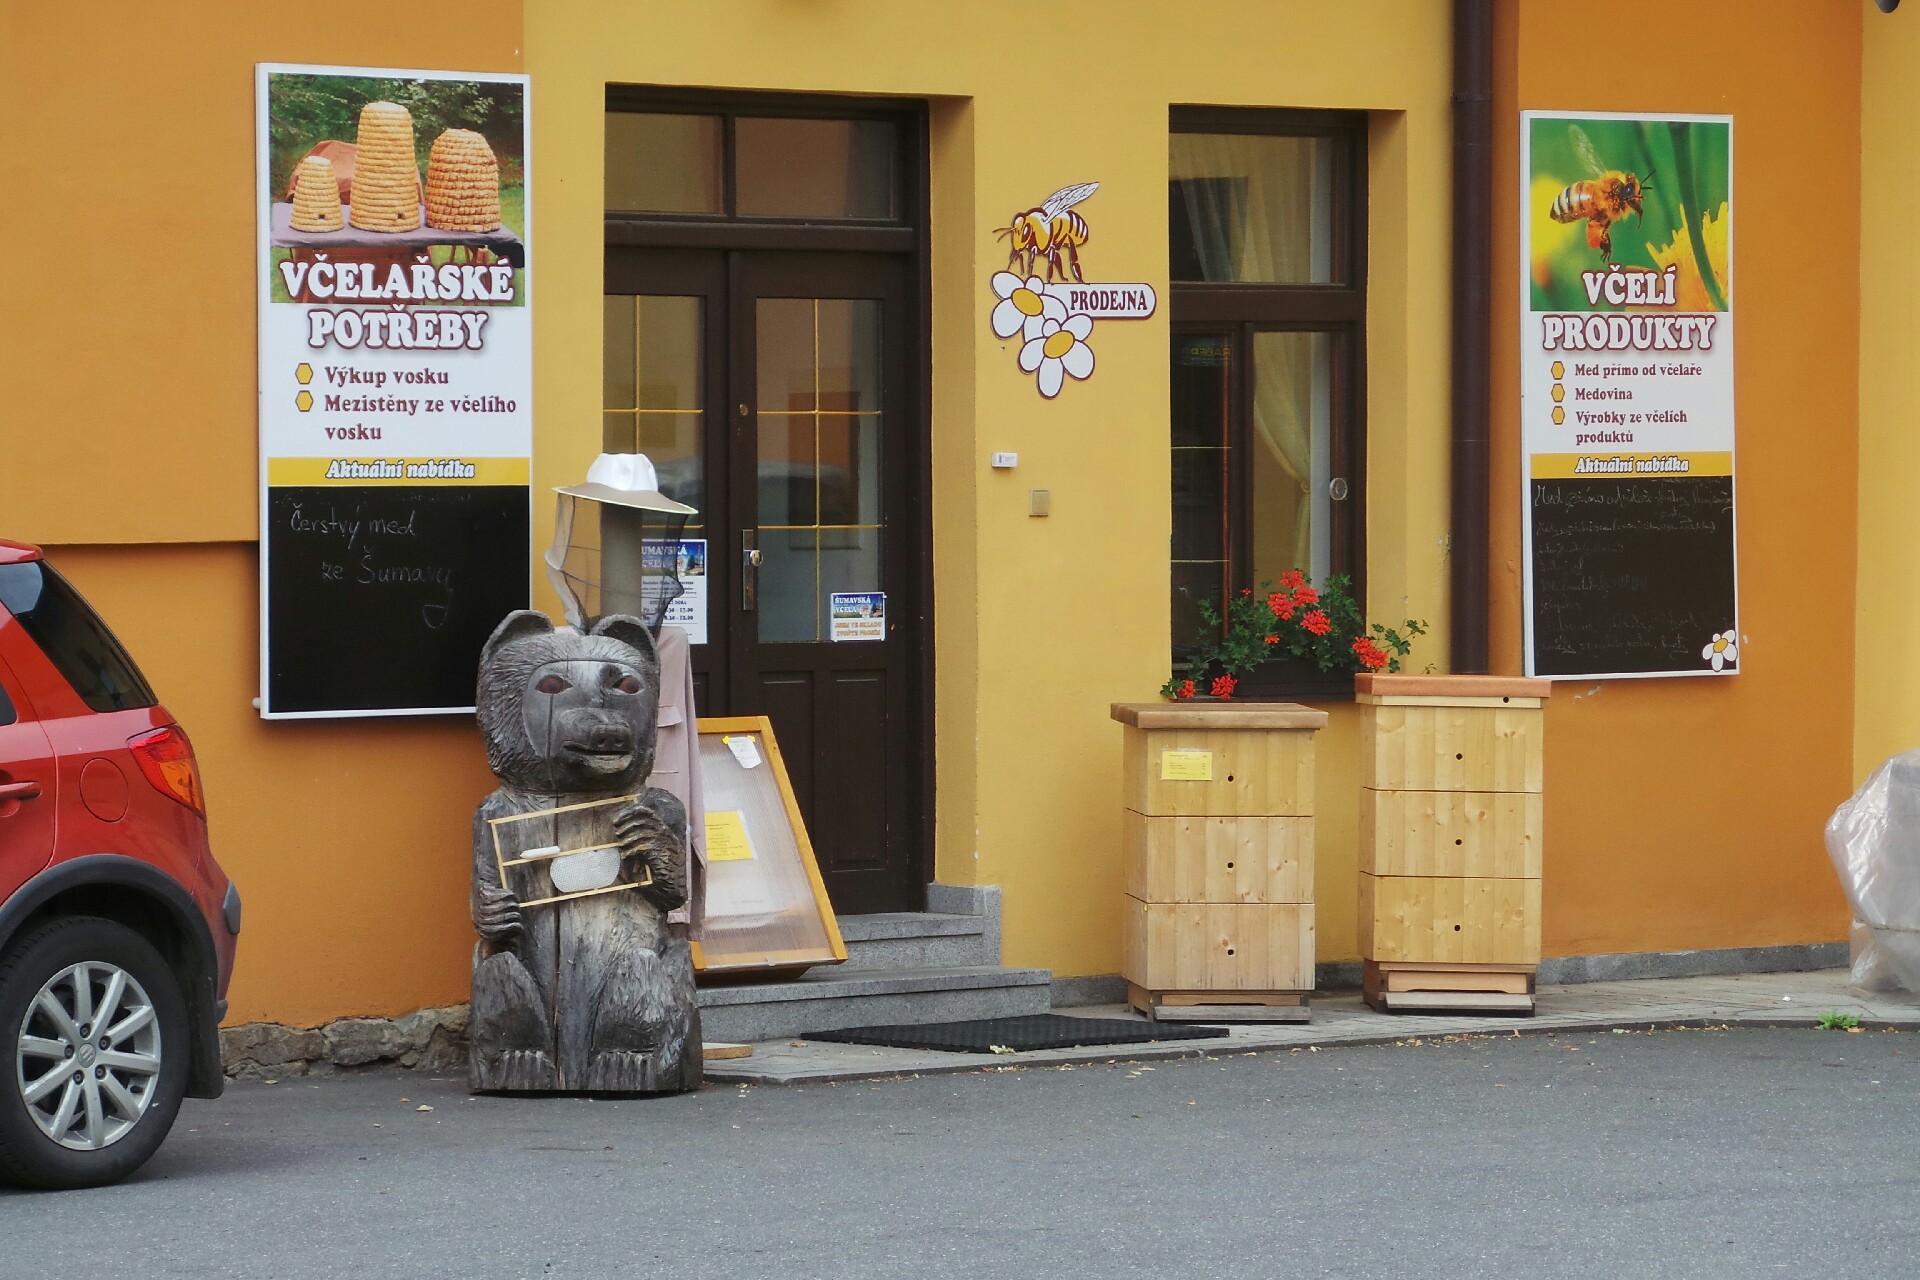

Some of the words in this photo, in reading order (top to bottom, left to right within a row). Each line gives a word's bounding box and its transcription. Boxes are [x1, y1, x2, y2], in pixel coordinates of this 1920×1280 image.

[278, 253, 515, 301] VČELAŘSKÉ
[1581, 263, 1677, 306] VČELÍ
[1070, 289, 1148, 312] PRODEJNA
[307, 303, 489, 350] POTŘEBY
[1543, 314, 1716, 351] PRODUKTY
[325, 366, 387, 388] Výkup
[393, 367, 449, 385] vosku
[1575, 364, 1600, 376] Med
[1603, 363, 1639, 379] přímo
[1642, 364, 1657, 376] od
[1660, 363, 1702, 376] včelaře
[1574, 388, 1633, 401] Medovina
[324, 394, 419, 416] Mezistěny
[425, 398, 444, 412] ze
[450, 394, 517, 413] včelího
[1576, 411, 1626, 426] Výrobky
[1630, 413, 1642, 423] ze
[1645, 410, 1688, 423] včelích
[324, 423, 382, 440] vosku
[1575, 430, 1634, 445] produktů
[326, 459, 404, 479] Aktuální
[406, 459, 475, 479] nabídka
[1574, 457, 1634, 474] Aktuální
[1636, 455, 1690, 473] nabídka
[291, 503, 360, 550] Čerstvý
[368, 509, 417, 536] med
[322, 562, 344, 580] ze
[834, 596, 871, 604] ŠUMAVSKÁ
